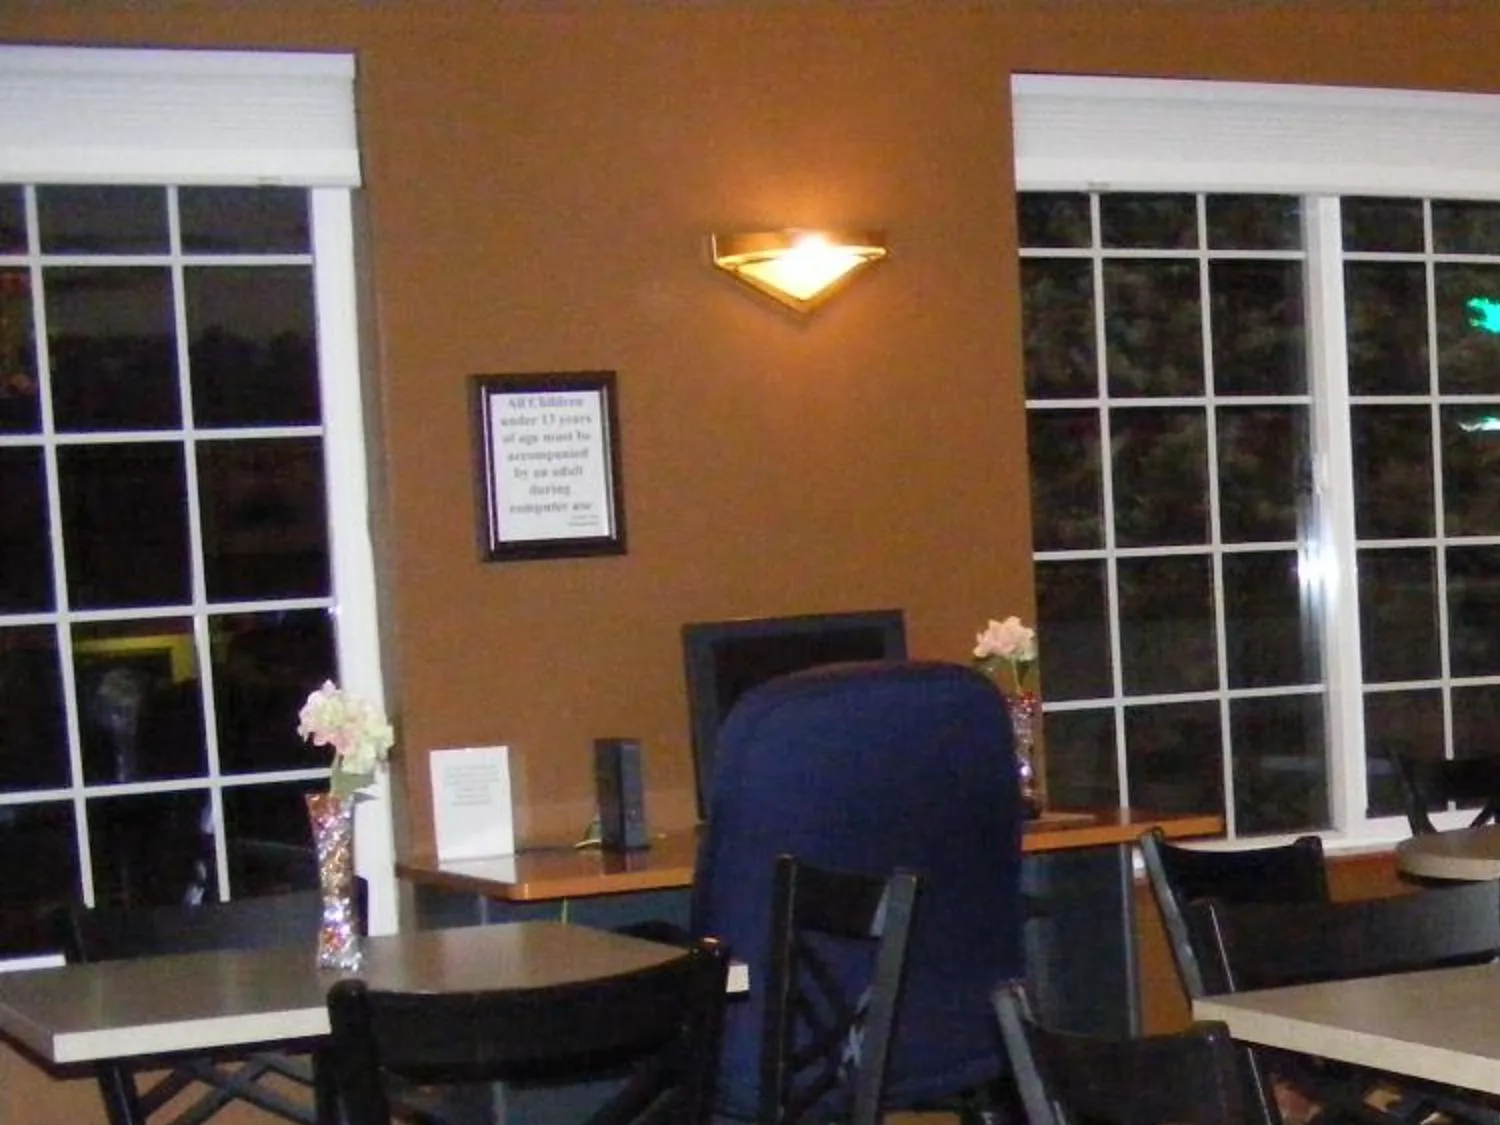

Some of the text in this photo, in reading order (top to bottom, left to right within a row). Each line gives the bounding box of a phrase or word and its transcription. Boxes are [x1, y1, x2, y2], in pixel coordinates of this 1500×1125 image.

[501, 415, 536, 426] under
[559, 414, 592, 425] years
[507, 449, 589, 462] accompanied
